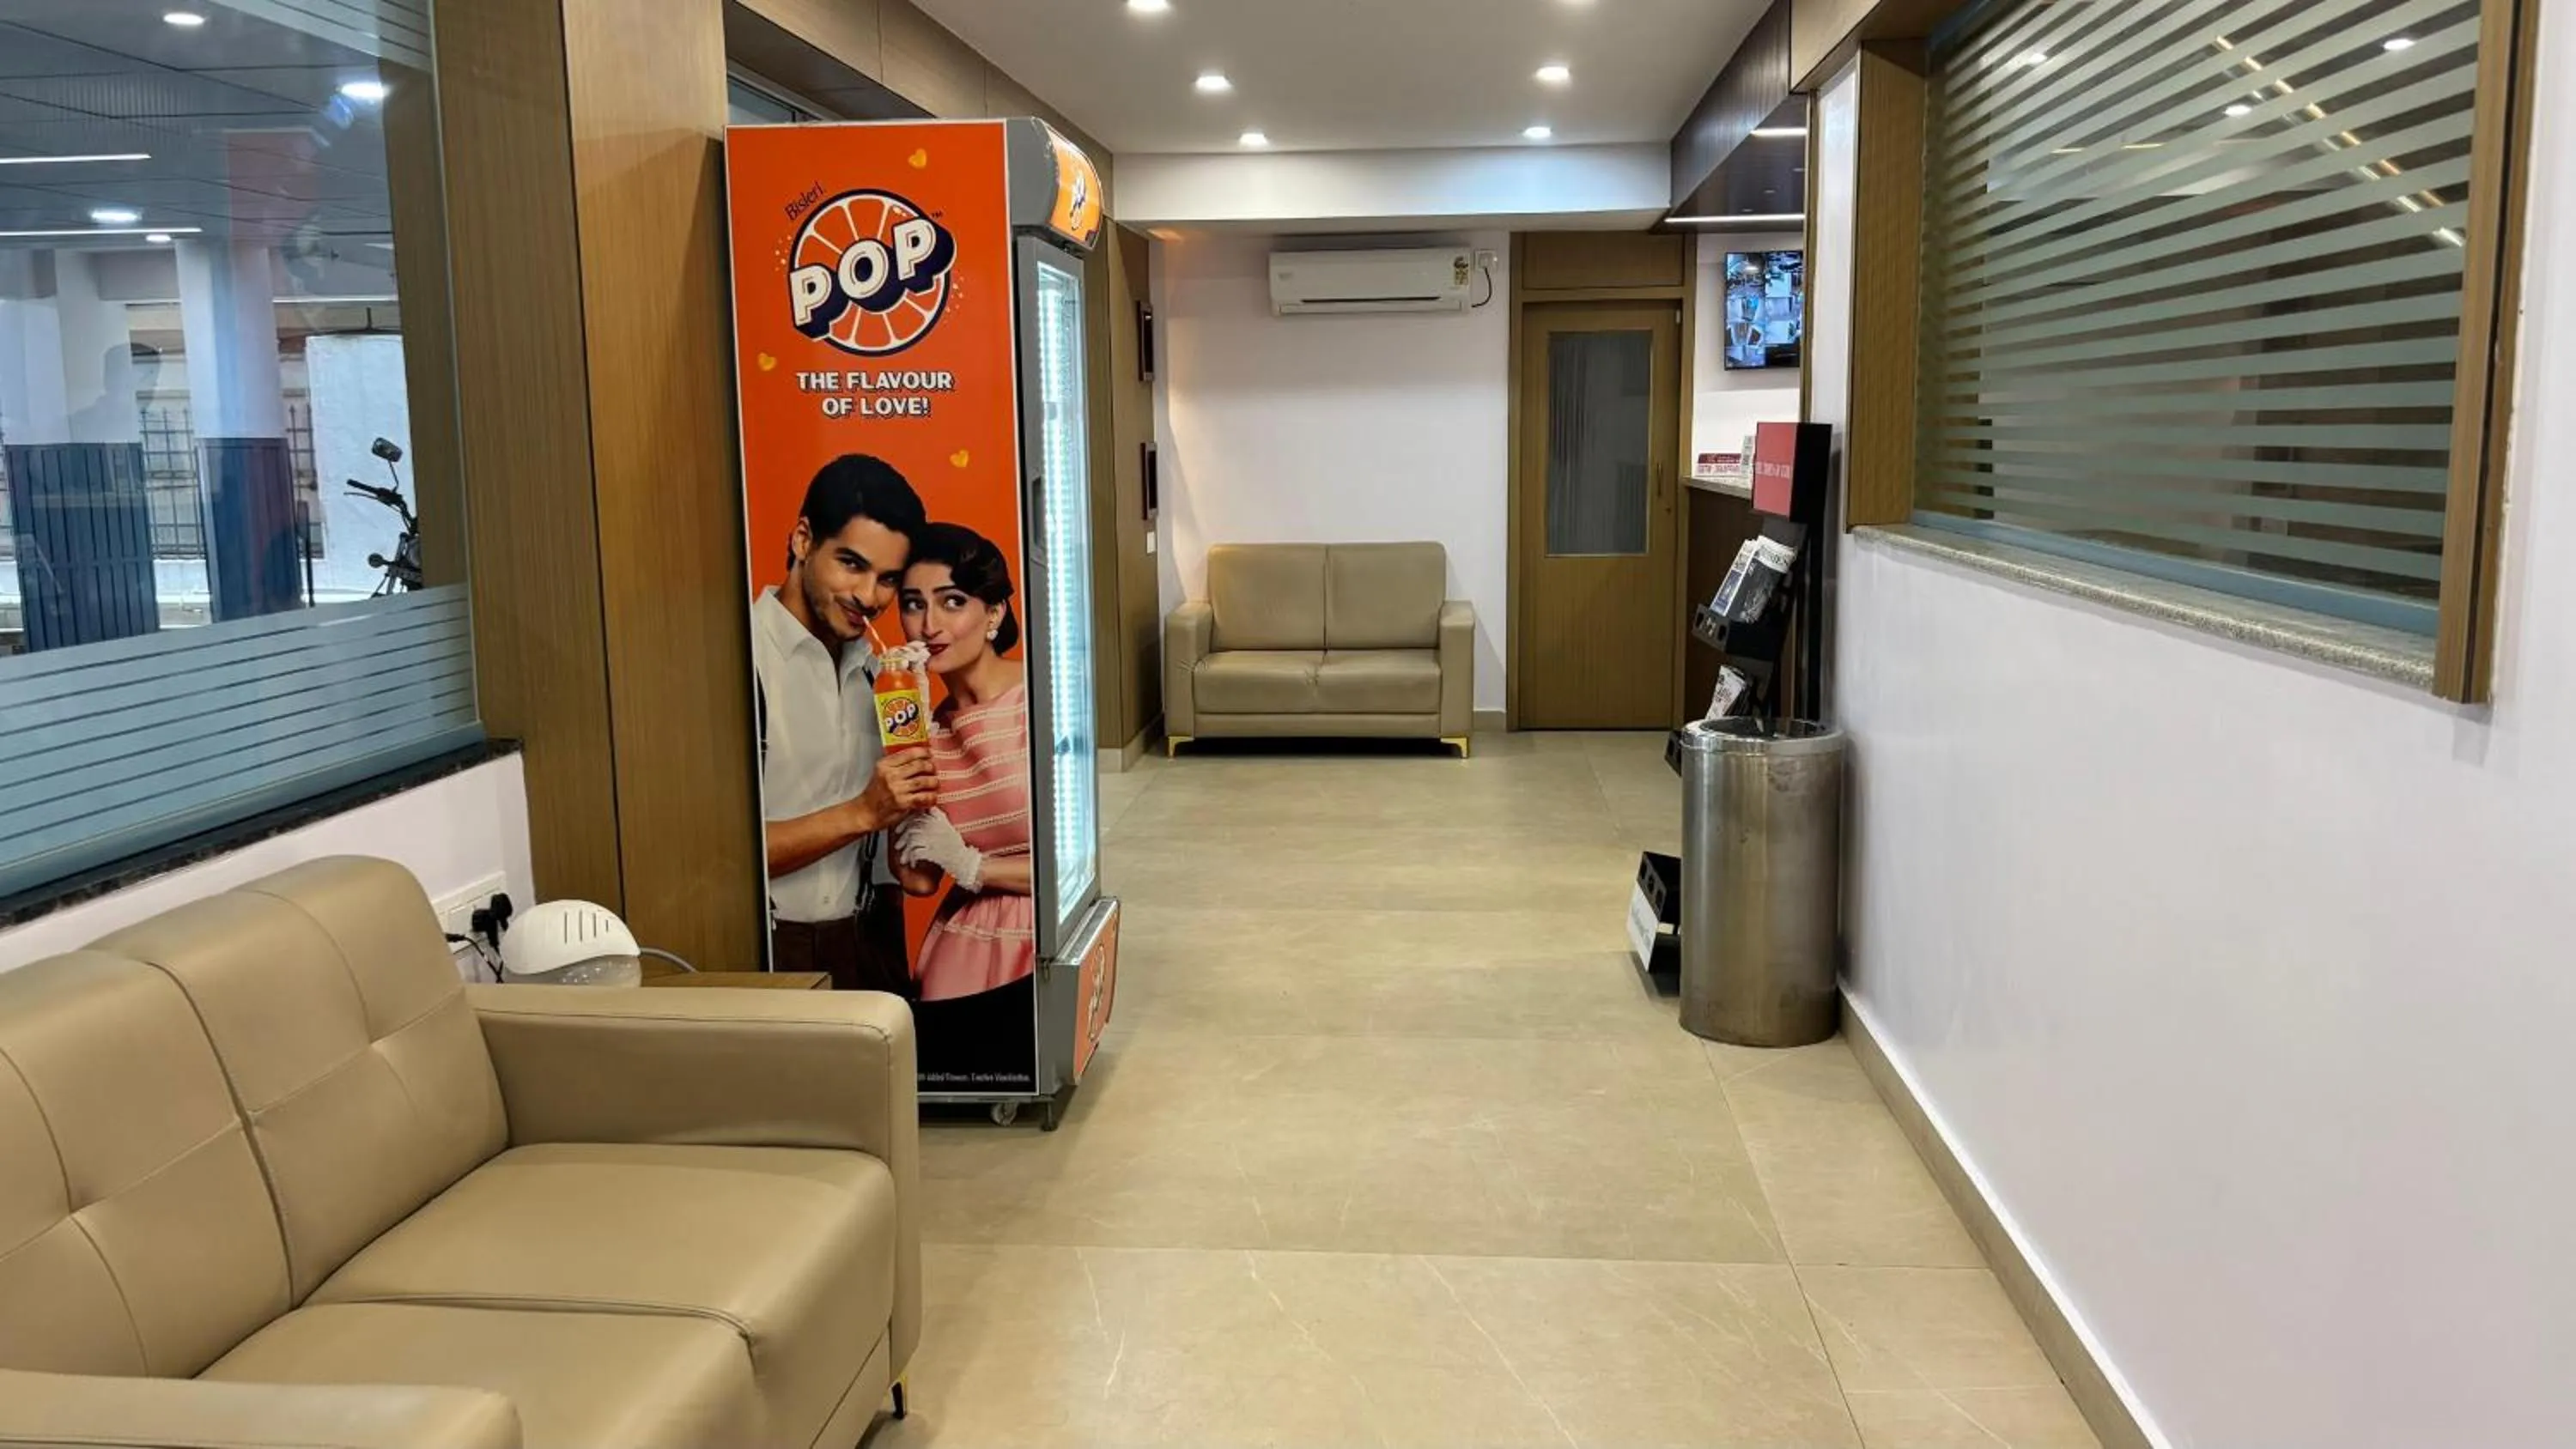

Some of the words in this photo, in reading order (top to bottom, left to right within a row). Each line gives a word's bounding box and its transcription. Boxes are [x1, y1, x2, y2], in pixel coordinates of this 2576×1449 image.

[789, 218, 937, 326] POP
[796, 372, 840, 390] THE
[847, 372, 953, 390] FLAVOUR
[822, 397, 853, 415] OF
[860, 397, 929, 415] LOVE!
[884, 703, 916, 731] POP
